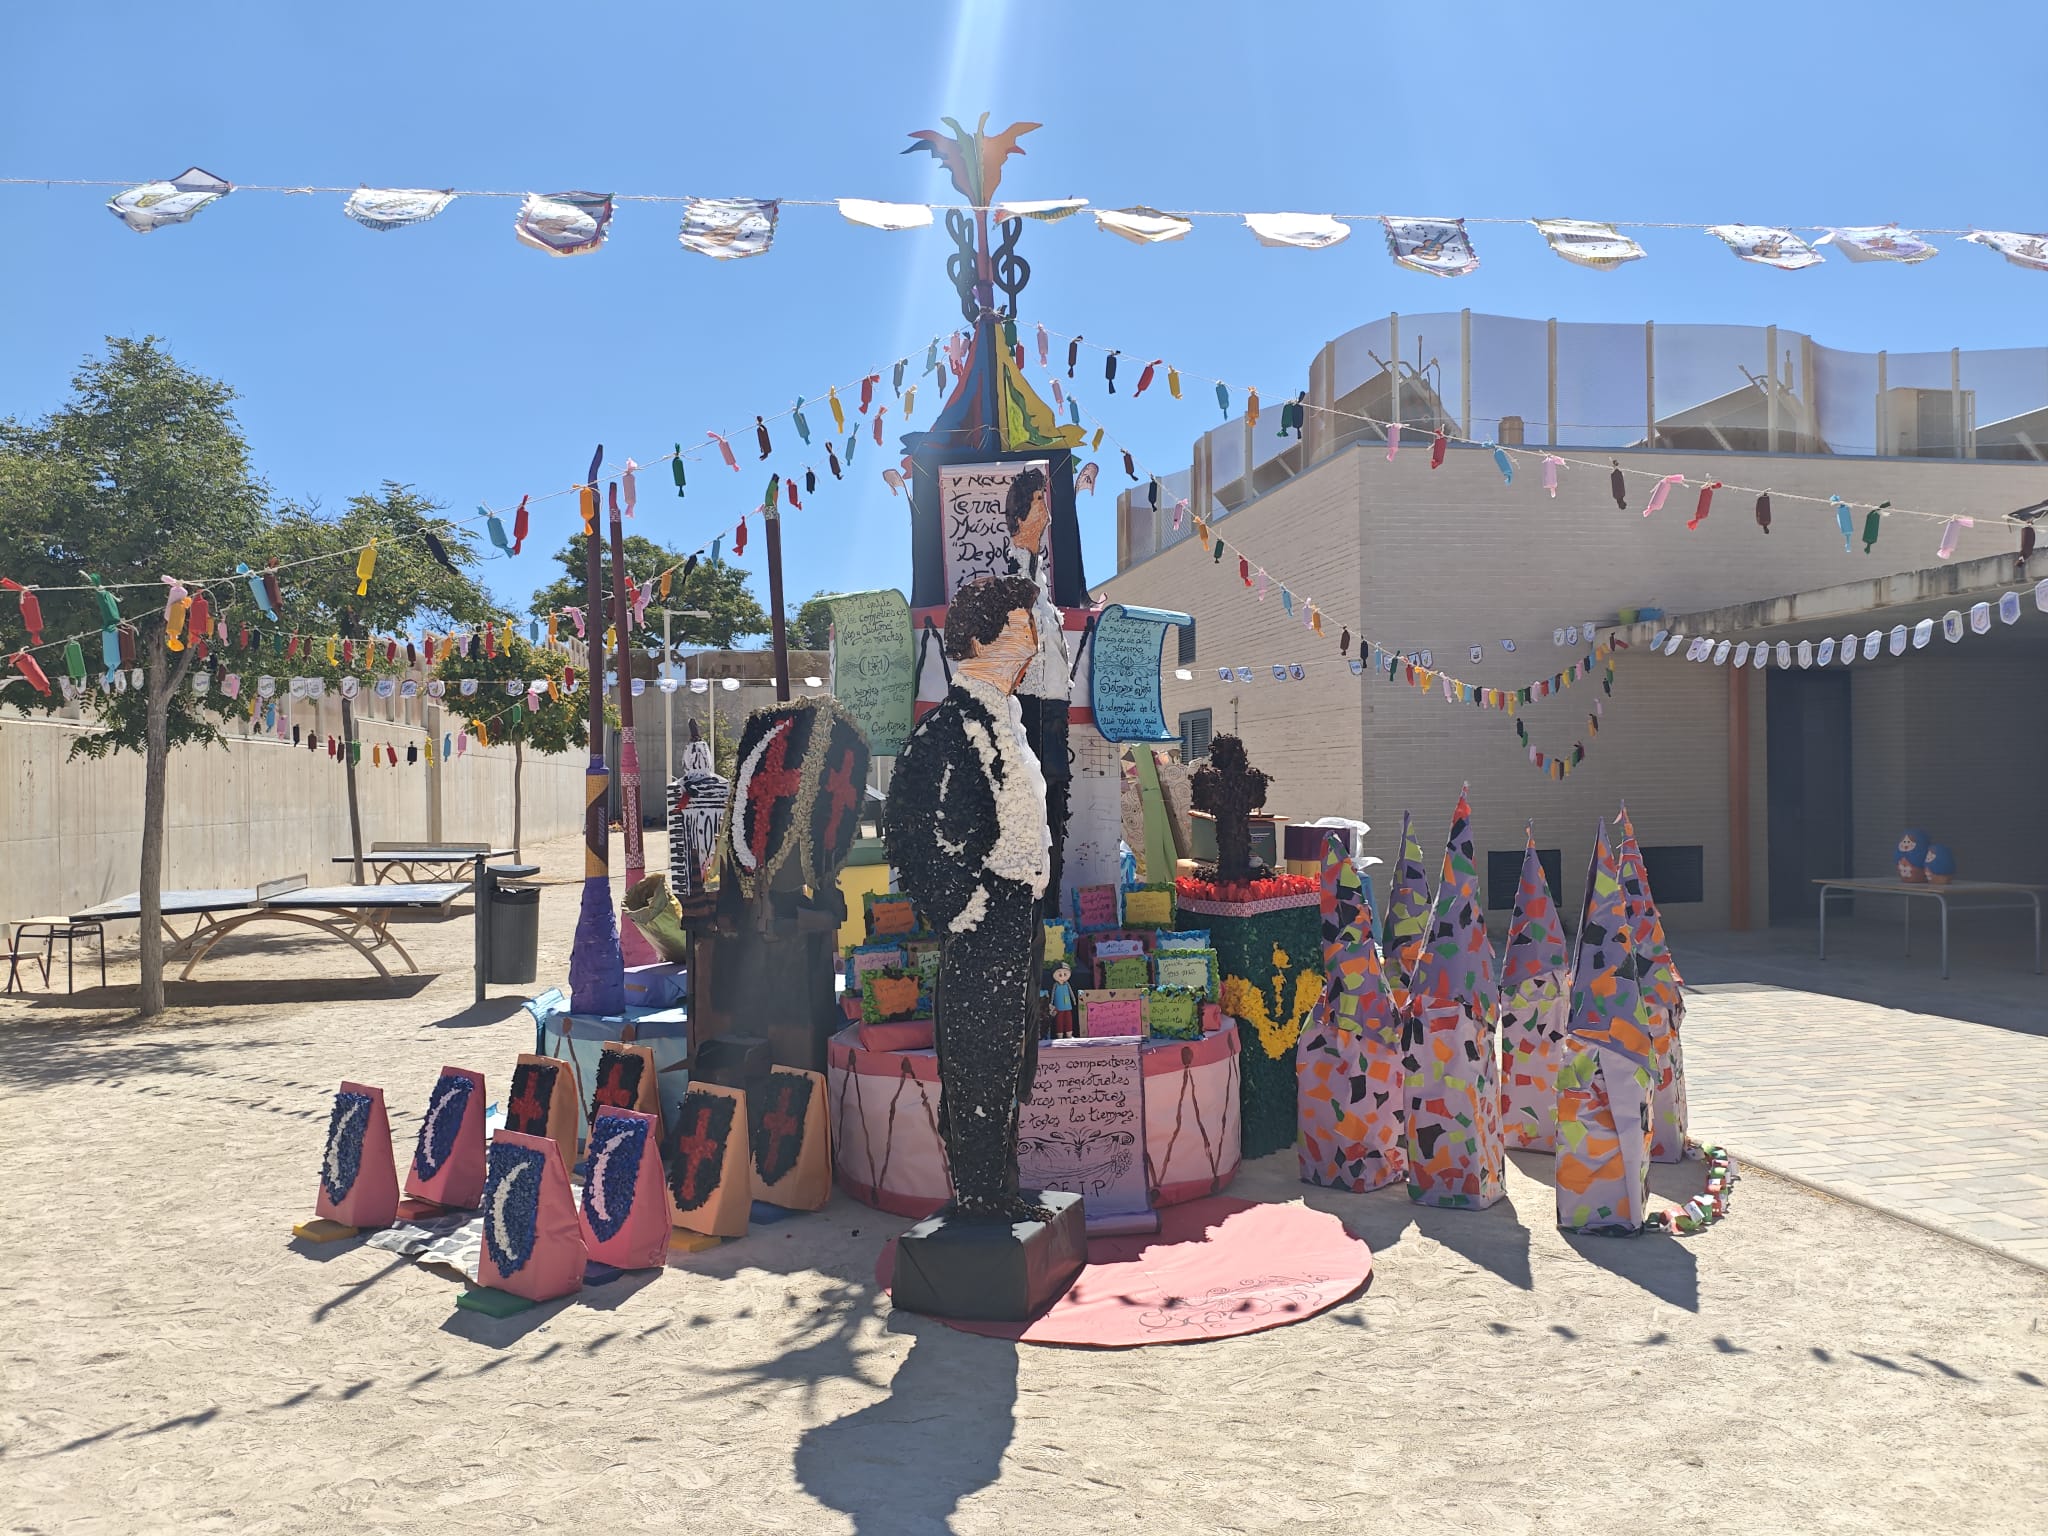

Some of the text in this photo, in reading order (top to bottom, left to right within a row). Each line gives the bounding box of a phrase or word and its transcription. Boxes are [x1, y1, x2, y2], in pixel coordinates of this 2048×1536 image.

[949, 515, 1009, 541] Músic
[1066, 1054, 1138, 1074] compositores
[1057, 1071, 1130, 1093] magistrales
[1058, 1089, 1126, 1108] maestras
[1069, 1107, 1086, 1123] los
